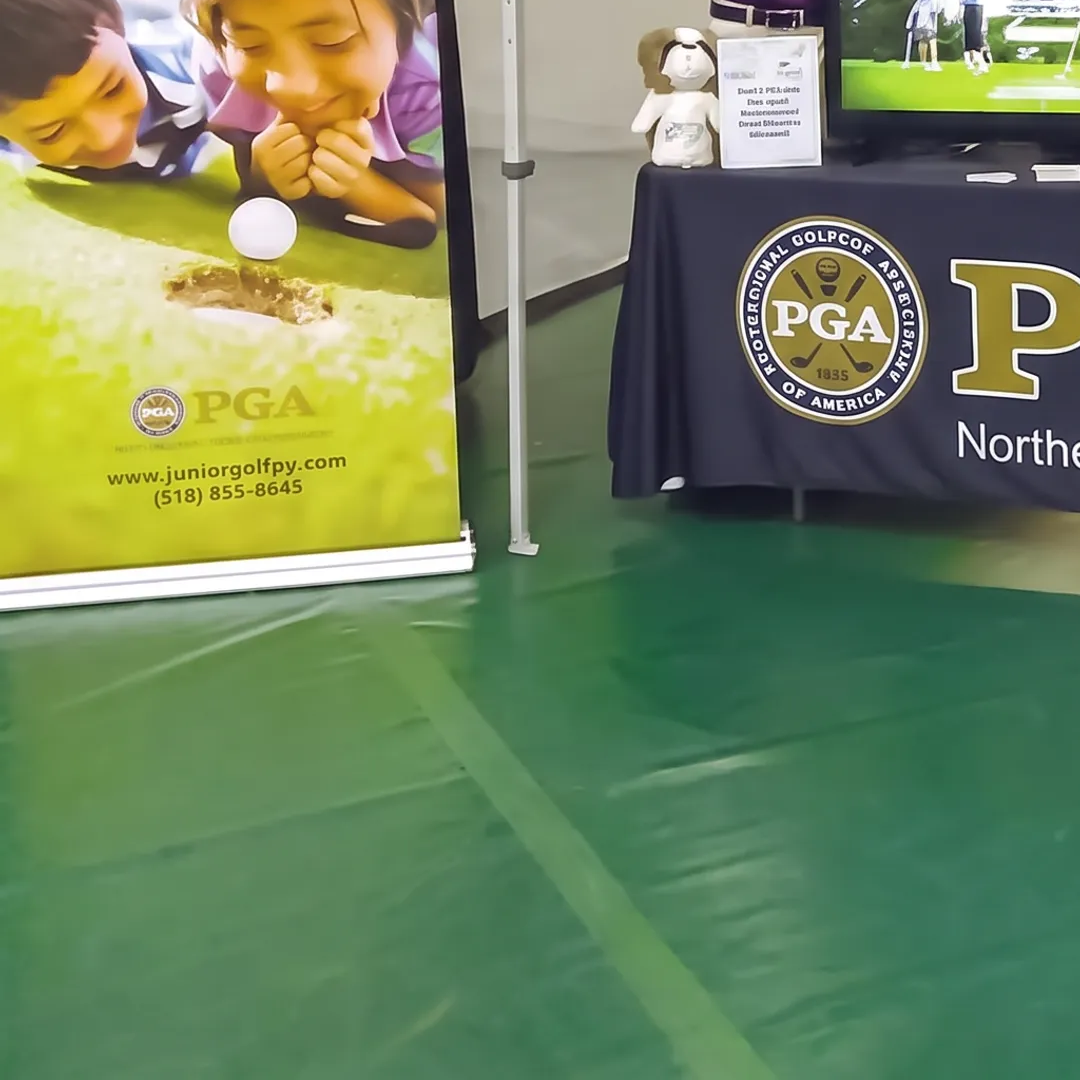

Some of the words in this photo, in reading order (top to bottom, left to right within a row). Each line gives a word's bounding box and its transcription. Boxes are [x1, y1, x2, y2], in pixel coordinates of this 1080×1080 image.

[771, 300, 892, 344] PGA
[194, 384, 316, 424] PGA
[781, 382, 806, 400] OF
[811, 387, 887, 412] AMERICA
[107, 455, 347, 486] www.juniorgolfpy.com
[154, 487, 203, 509] (518)
[209, 479, 303, 501] 855-8645
